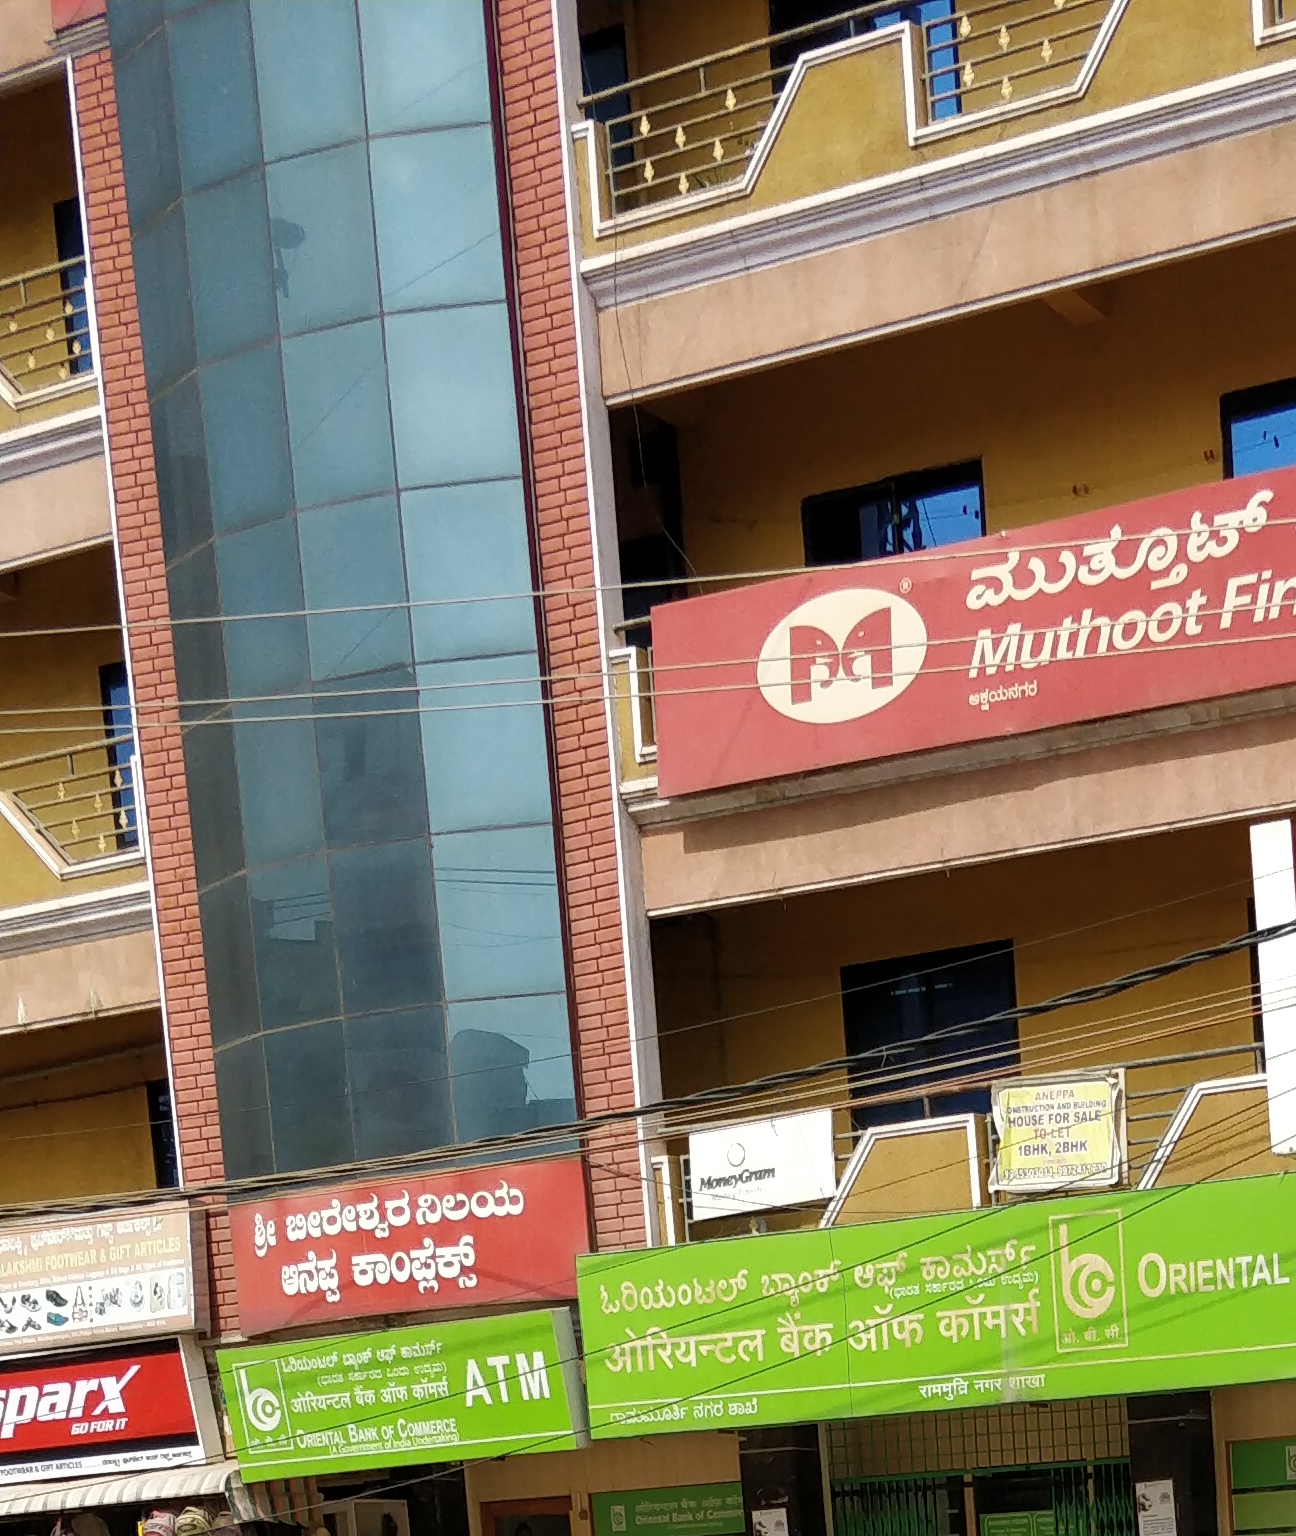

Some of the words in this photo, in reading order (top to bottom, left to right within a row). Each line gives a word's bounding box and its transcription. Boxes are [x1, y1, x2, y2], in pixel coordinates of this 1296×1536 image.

[965, 489, 1275, 610] ಮುತ್ತೂಟ್
[967, 592, 1208, 678] Muthoot
[968, 679, 1038, 711] ಅಕ್ಷಯನಗರ
[1035, 1089, 1075, 1101] ANEPPA
[1057, 1102, 1071, 1110] AND
[1008, 1115, 1044, 1128] HOUSE
[1048, 1112, 1070, 1124] FOR
[1073, 1110, 1101, 1123] SALE
[1018, 1143, 1051, 1157] 1BHK,
[1055, 1140, 1088, 1153] 2BHK
[699, 1167, 776, 1191] MoneyGram
[254, 1212, 277, 1258] ಶ್ರೀ
[286, 1189, 411, 1242] ಬೀರೇಶ್ವರ
[415, 1180, 526, 1226] ನಿಲಯ
[44, 1249, 97, 1271] FOOTWEAR
[100, 1247, 107, 1262] &
[109, 1243, 131, 1261] GIFT
[133, 1236, 182, 1257] ARTICLES
[761, 1258, 842, 1307] ಬ್ಯಾಂಕ್
[854, 1251, 908, 1294] ಆಫ್
[1137, 1251, 1289, 1298] ORIENTAL
[604, 1326, 766, 1373] ओरियन्टल
[777, 1312, 833, 1357] बैंक
[849, 1302, 924, 1351] ऑफ
[935, 1287, 1041, 1344] कॉमर्स
[465, 1351, 550, 1407] ATM
[973, 1377, 1002, 1393] नगर
[1009, 1374, 1046, 1390] शाखा
[291, 1391, 351, 1414] ओरियन्टल
[354, 1385, 376, 1406] बैंक
[380, 1382, 408, 1403] ऑफ
[411, 1376, 449, 1400] कॉमर्स
[693, 1399, 724, 1419] ನಗರ
[71, 1423, 89, 1435] GO
[90, 1420, 114, 1433] FOR
[115, 1417, 128, 1430] IT
[381, 1425, 395, 1440] OF
[339, 1443, 382, 1454] Government
[384, 1440, 393, 1450] of
[393, 1437, 412, 1448] India
[695, 1510, 704, 1520] of
